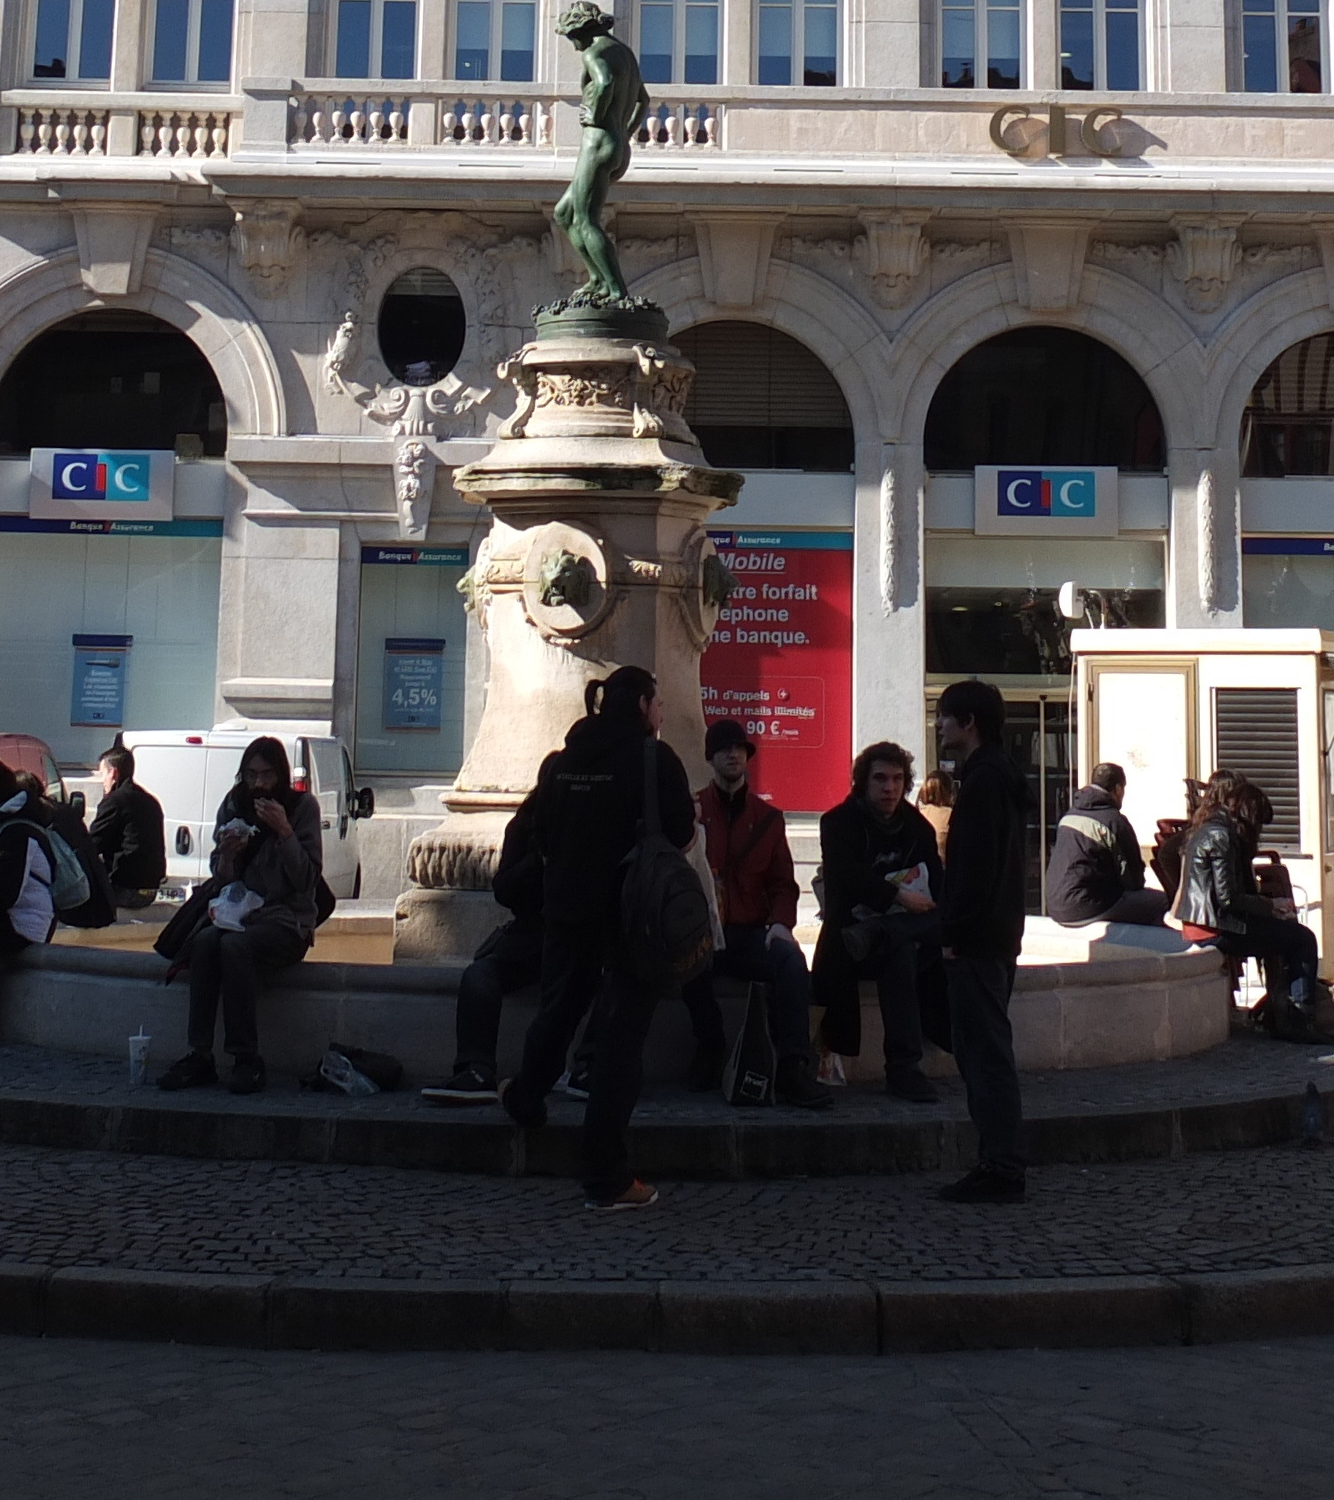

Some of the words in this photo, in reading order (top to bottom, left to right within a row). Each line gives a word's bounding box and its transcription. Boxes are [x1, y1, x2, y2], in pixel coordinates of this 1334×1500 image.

[990, 105, 1122, 155] CIC
[62, 462, 140, 492] CIC
[1007, 479, 1085, 508] CIC
[70, 521, 103, 532] Banque
[111, 522, 153, 531] Assurance
[737, 535, 781, 544] Assurance
[378, 551, 412, 561] Banque
[418, 552, 462, 560] Assurance
[718, 553, 785, 570] Mobile
[761, 583, 818, 600] forfait
[709, 631, 731, 642] ne
[736, 628, 810, 647] banque.
[392, 688, 437, 708] 4,5%
[723, 690, 770, 701] d'appels
[705, 706, 728, 715] Web
[731, 707, 742, 715] et
[744, 706, 772, 716] mails
[770, 721, 781, 735] €
